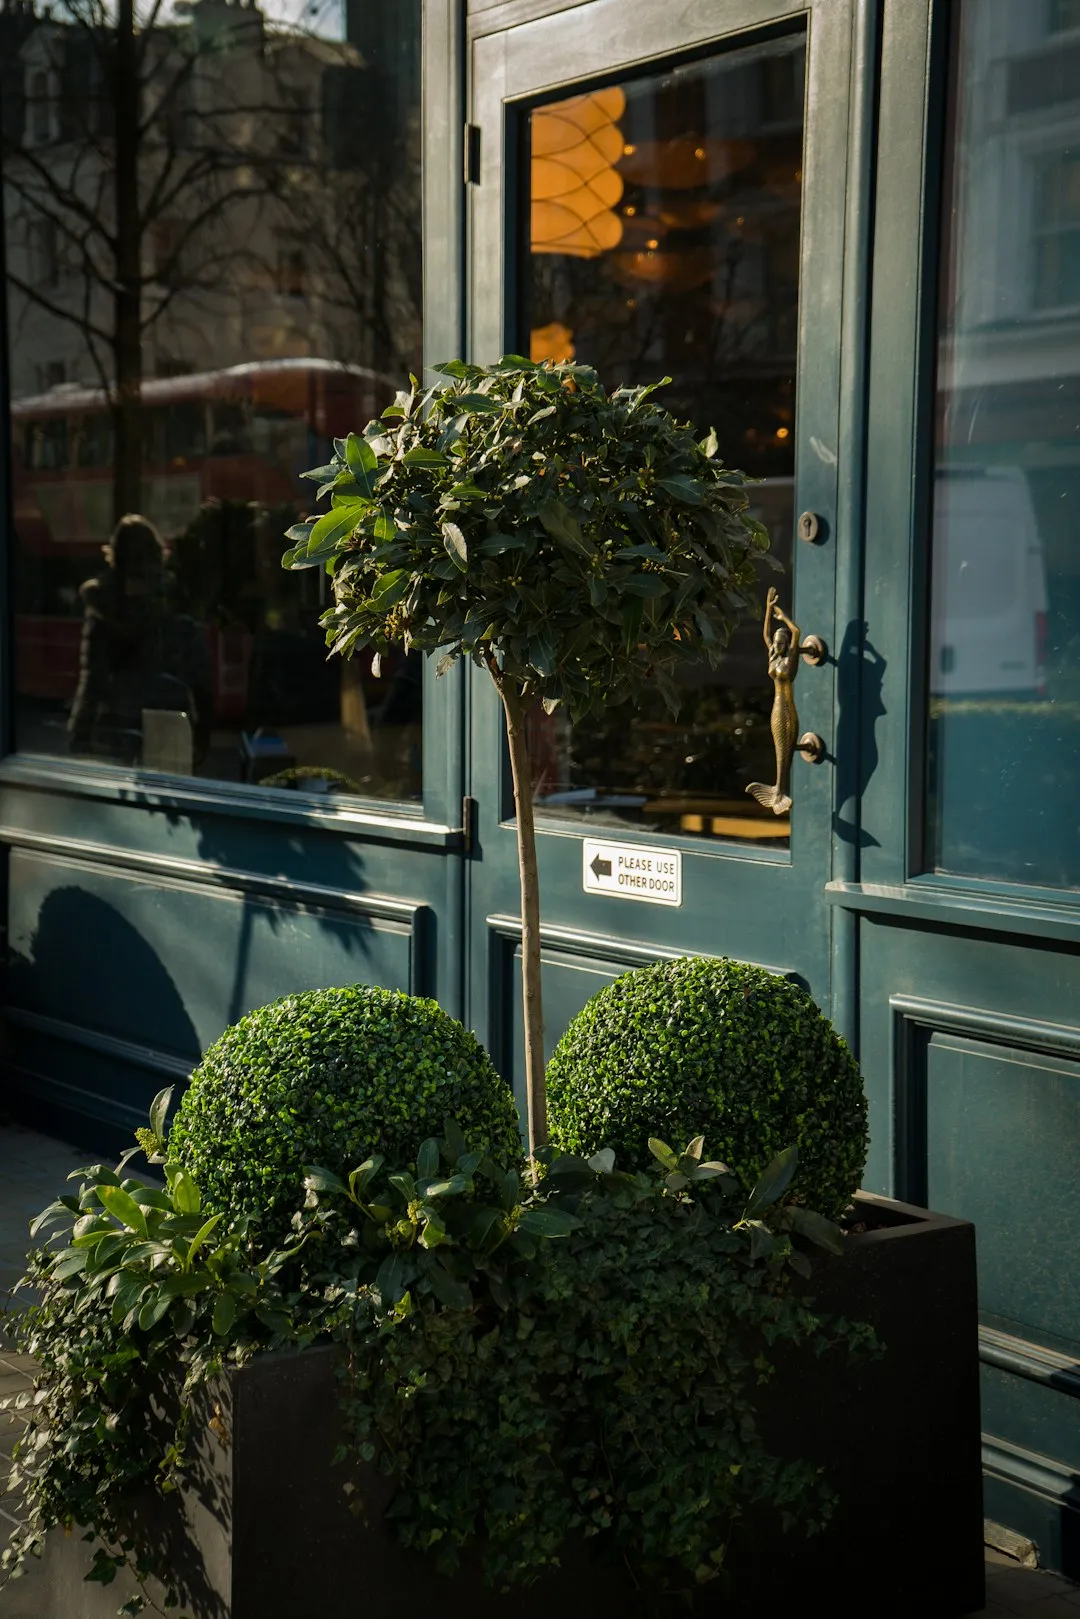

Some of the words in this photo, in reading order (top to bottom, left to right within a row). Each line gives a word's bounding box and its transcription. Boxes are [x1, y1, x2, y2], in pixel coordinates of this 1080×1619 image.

[618, 856, 652, 872] PLEASE
[656, 862, 675, 875] USE
[618, 873, 647, 888] OTHER
[649, 878, 675, 892] DOOR
